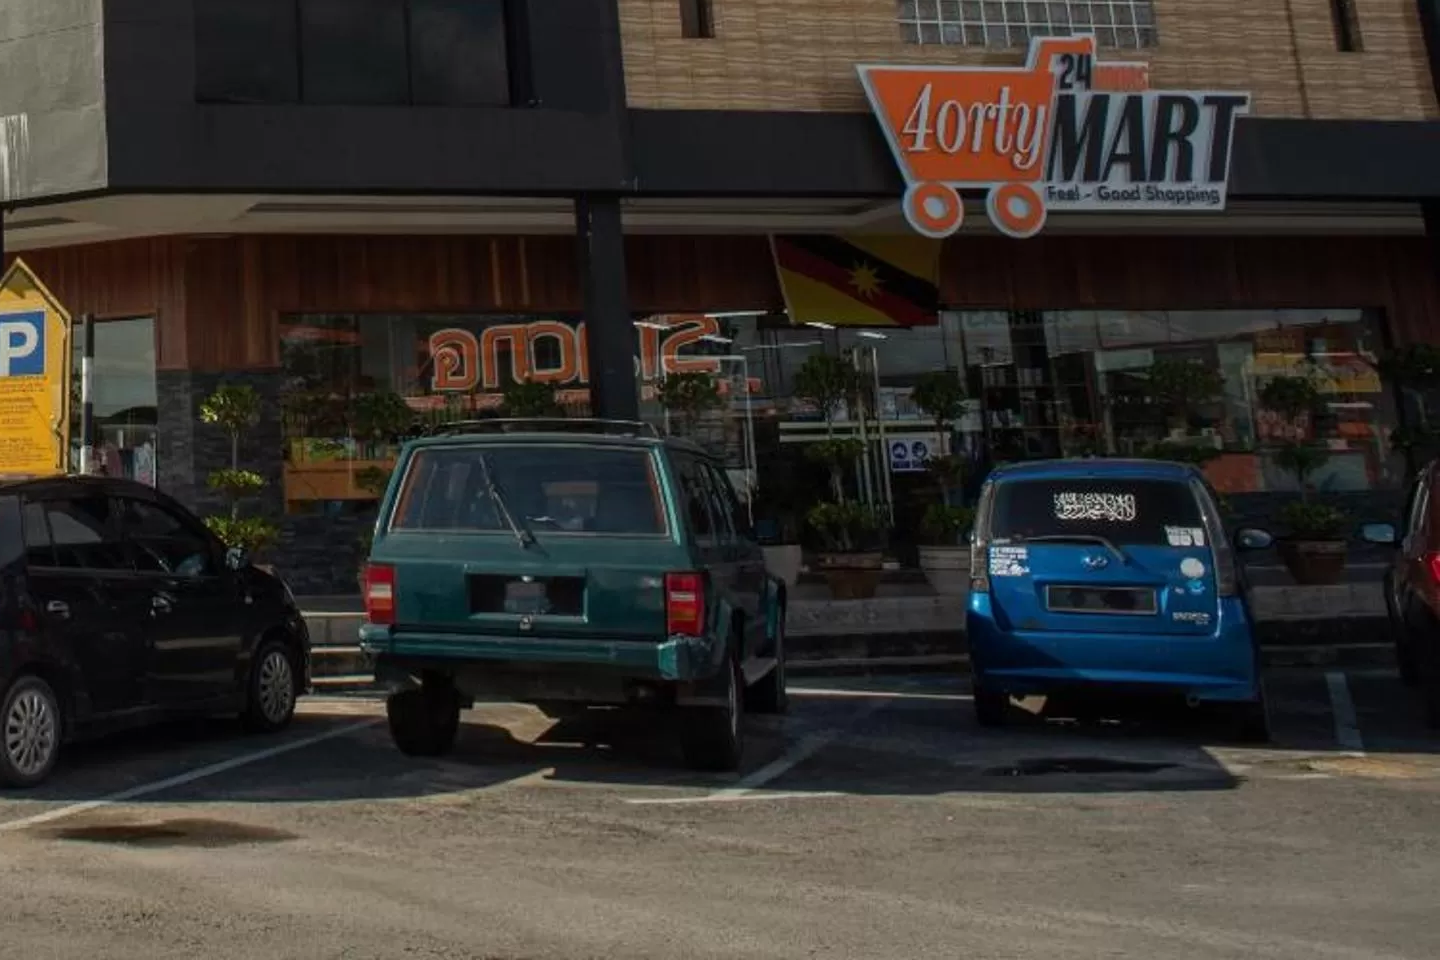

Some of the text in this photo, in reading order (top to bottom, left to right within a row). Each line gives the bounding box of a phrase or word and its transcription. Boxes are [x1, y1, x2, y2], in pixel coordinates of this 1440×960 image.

[1059, 53, 1092, 90] 24
[901, 82, 1248, 182] 4orty MART
[1047, 185, 1079, 201] Feel
[1097, 185, 1140, 201] Good
[1145, 185, 1221, 205] Shopping
